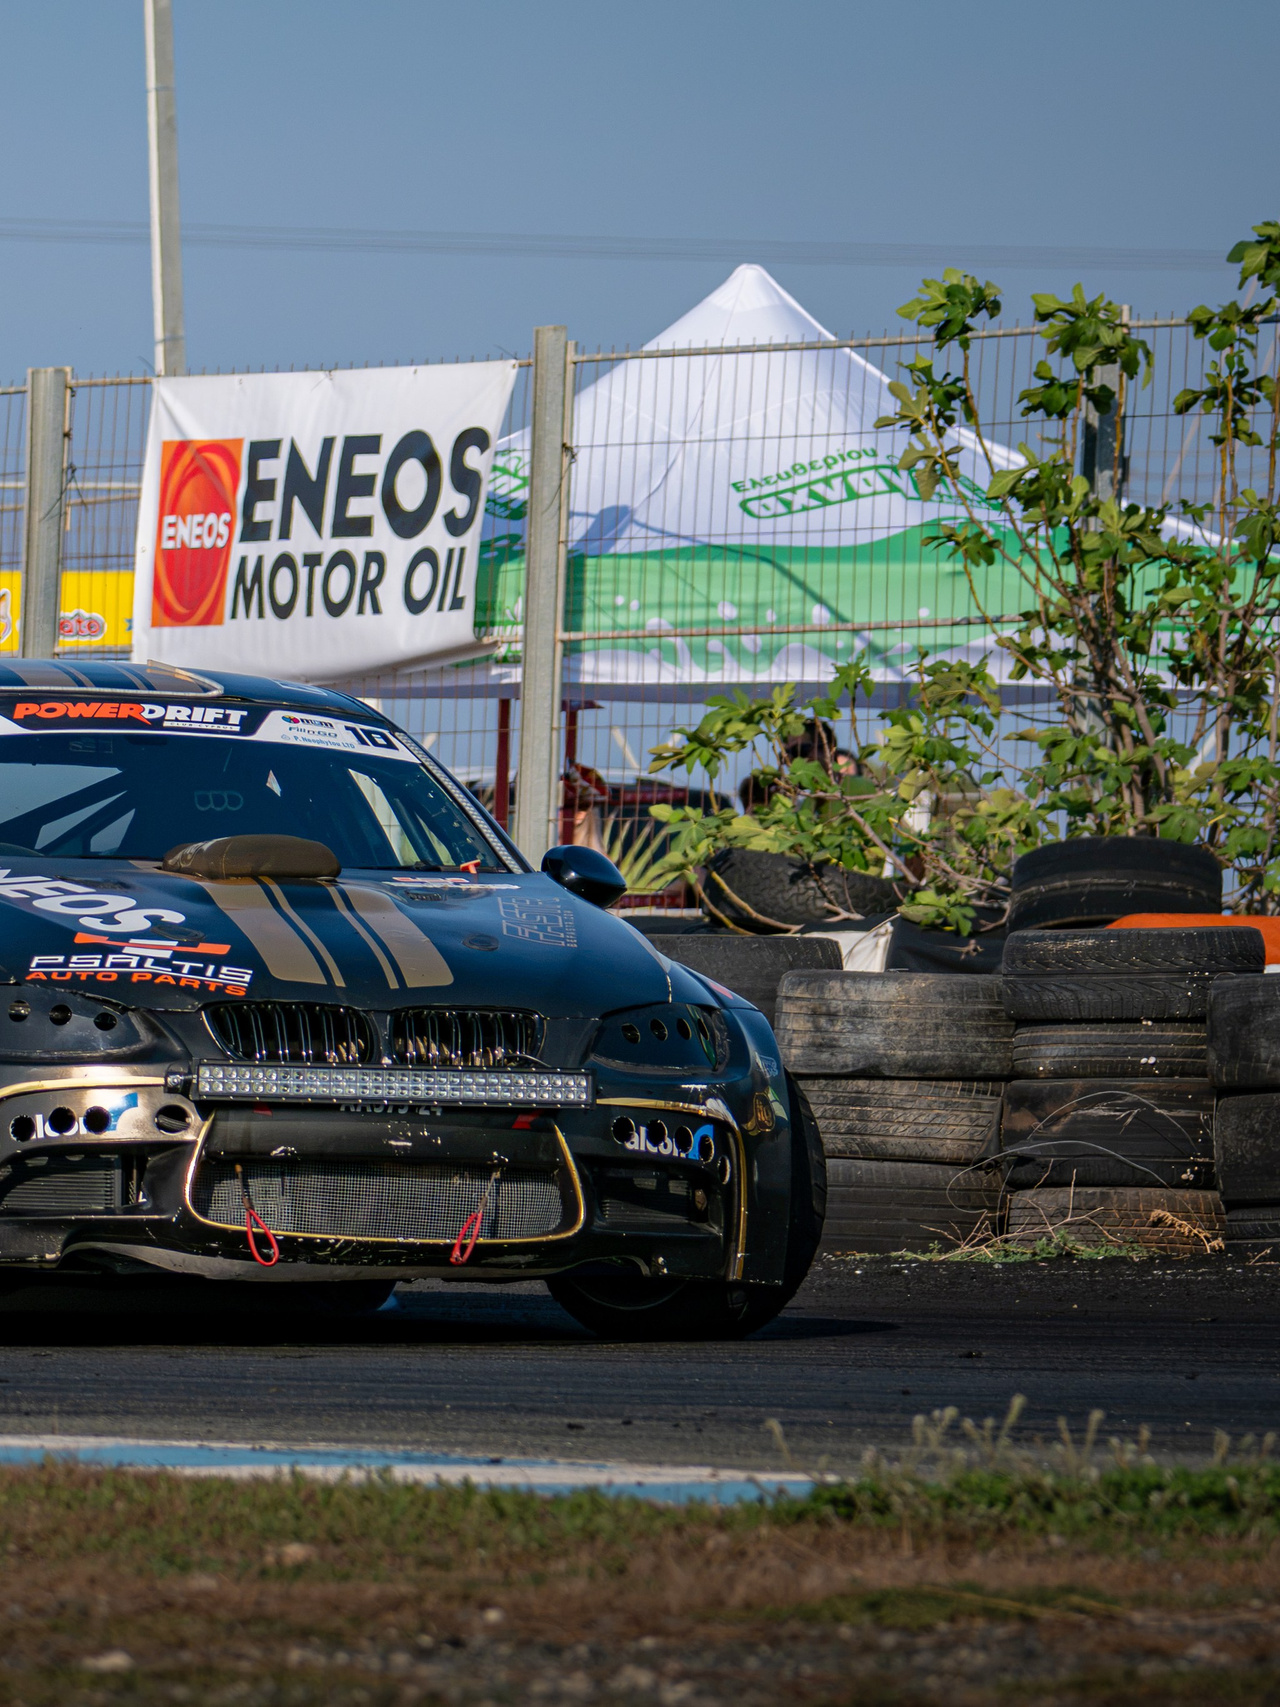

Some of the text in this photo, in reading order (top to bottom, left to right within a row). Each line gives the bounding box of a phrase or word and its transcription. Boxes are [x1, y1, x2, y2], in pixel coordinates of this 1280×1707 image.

[239, 427, 491, 543] ENEOS
[161, 512, 232, 550] ENEOS
[230, 546, 468, 620] MOTOR OIL
[12, 702, 248, 726] POWERDRIFT
[29, 954, 253, 981] PSALTIS
[25, 971, 247, 997] AUTO PARTS
